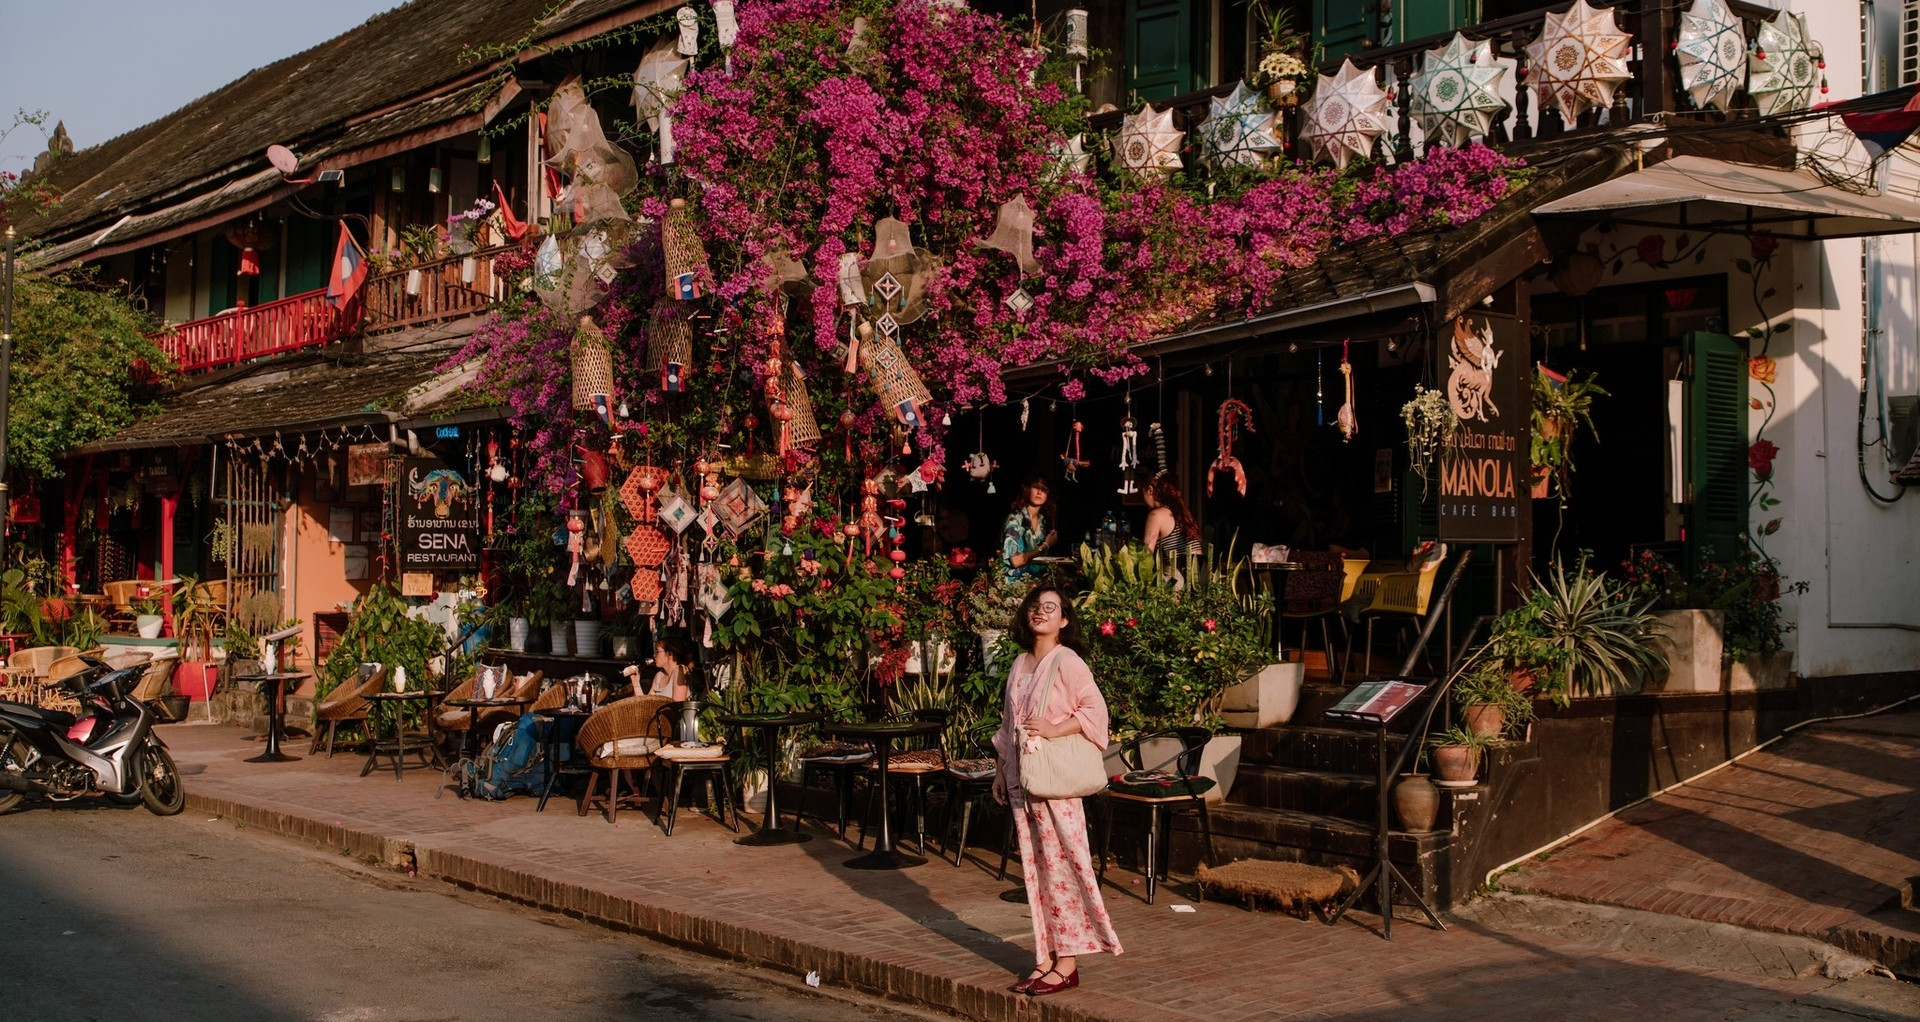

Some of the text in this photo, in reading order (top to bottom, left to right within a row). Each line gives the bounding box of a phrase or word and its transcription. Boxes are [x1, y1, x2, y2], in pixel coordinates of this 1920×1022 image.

[1441, 458, 1515, 498] MANOLA
[1441, 504, 1516, 517] CAFE BAR
[418, 533, 471, 554] SENA
[407, 553, 478, 562] RESTAURANT
